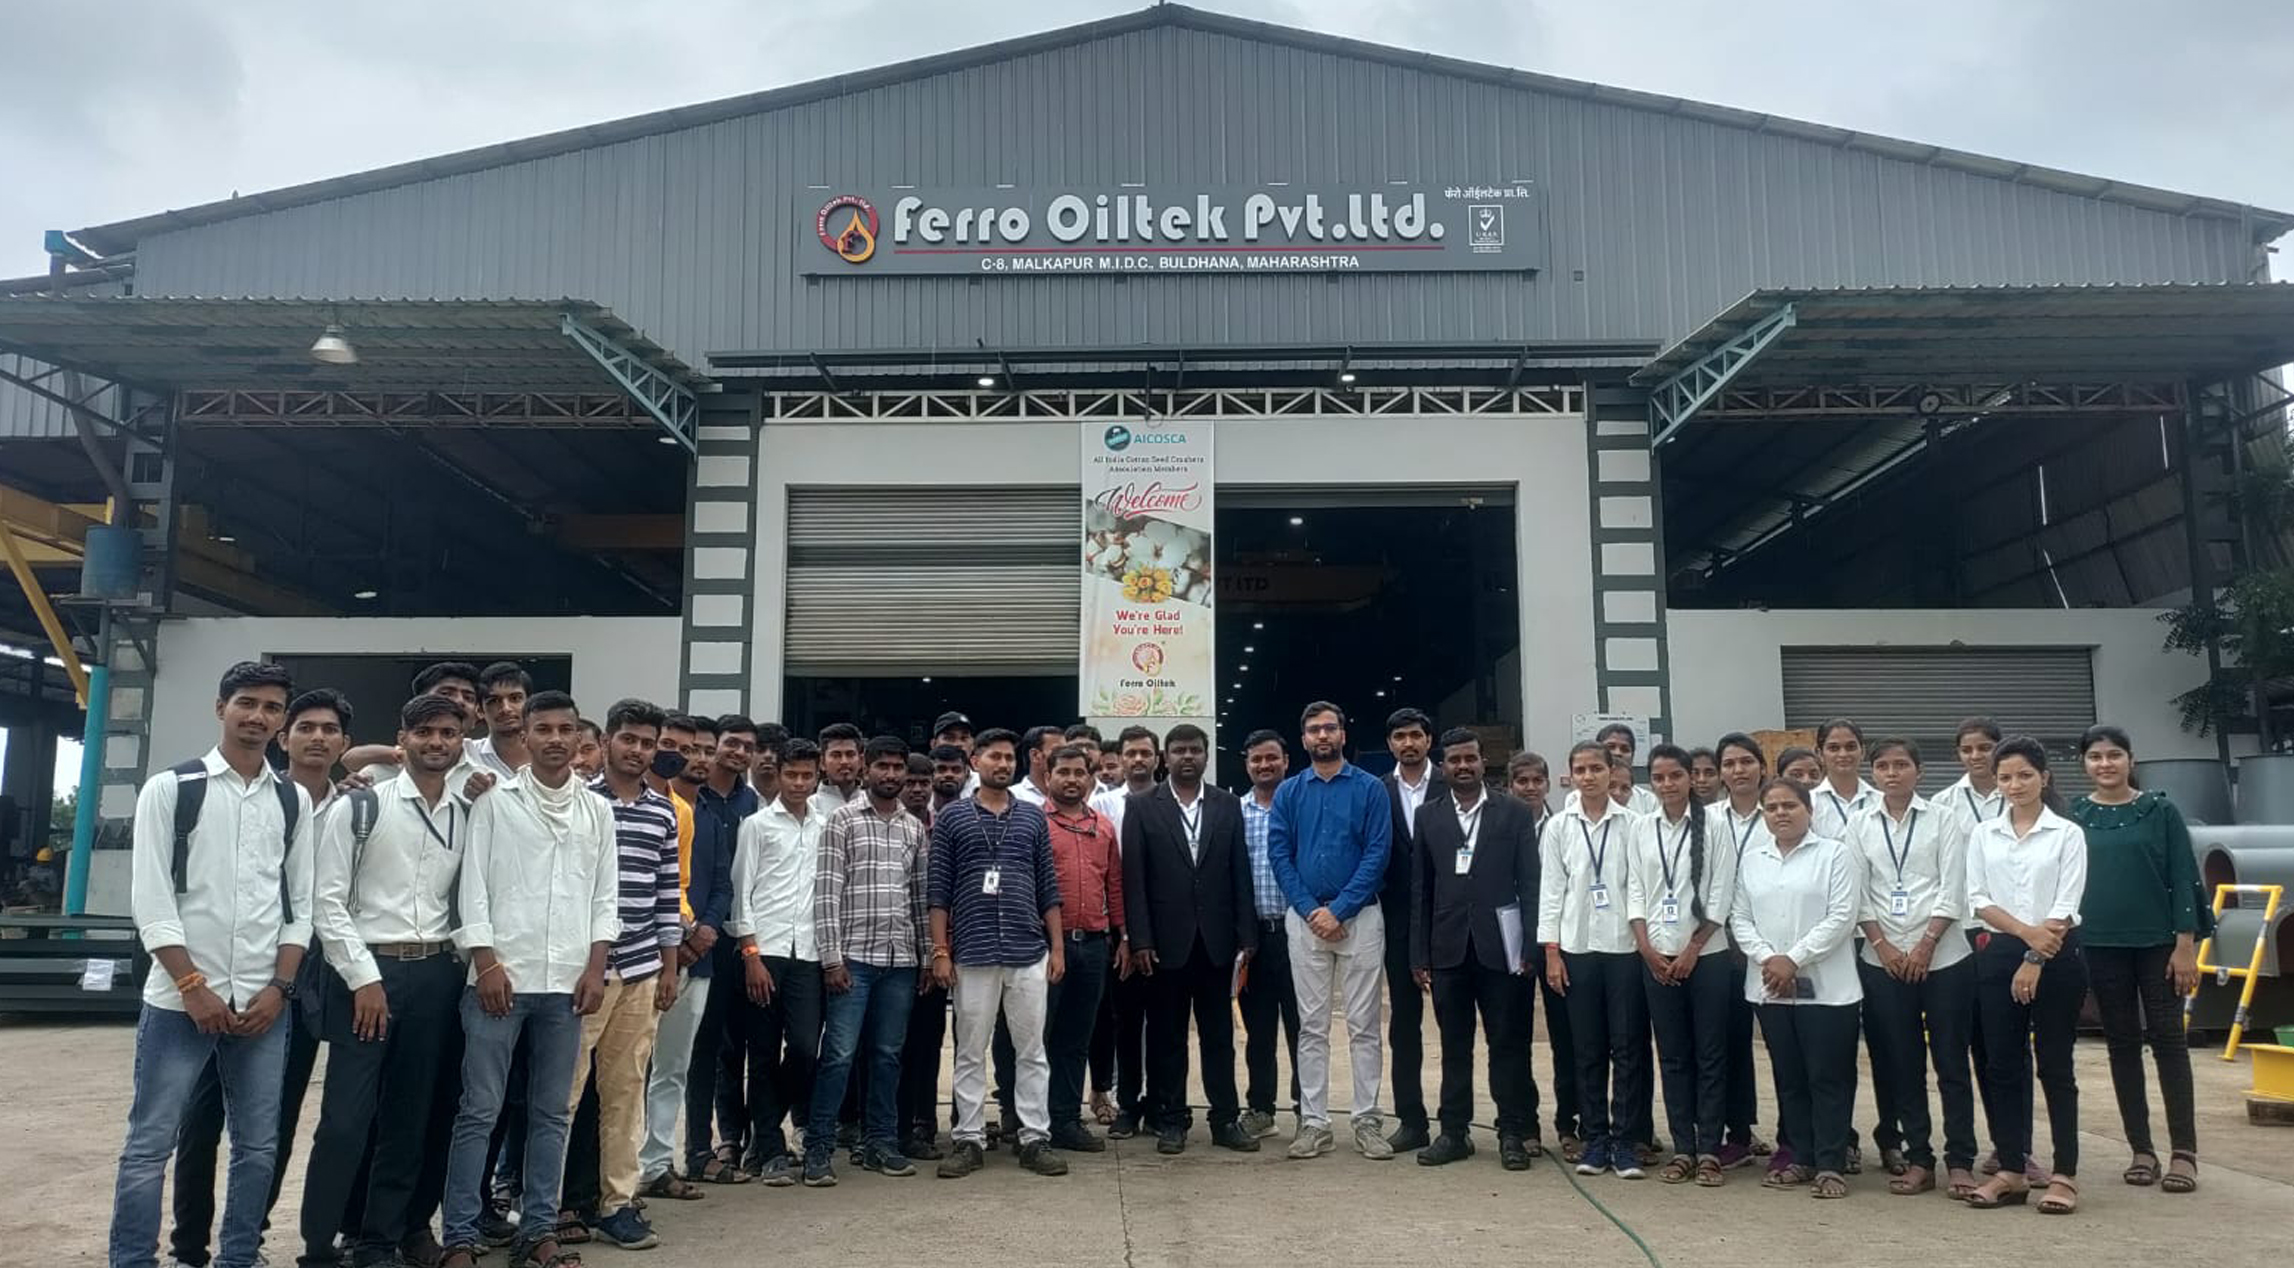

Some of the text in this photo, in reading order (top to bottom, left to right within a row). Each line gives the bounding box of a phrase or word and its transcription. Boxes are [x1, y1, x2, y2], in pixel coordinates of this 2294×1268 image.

[1046, 194, 1229, 242] Oiltek
[981, 257, 1009, 271] C-8,
[1012, 256, 1094, 270] MALKAPUR
[1159, 256, 1244, 270] BULDHANA,
[1247, 255, 1360, 269] MAHARASHTRA
[1133, 433, 1187, 444] AICOSCA
[1095, 481, 1202, 518] Welcome
[1115, 610, 1181, 621] We're Glad
[1113, 624, 1184, 635] You're Here!
